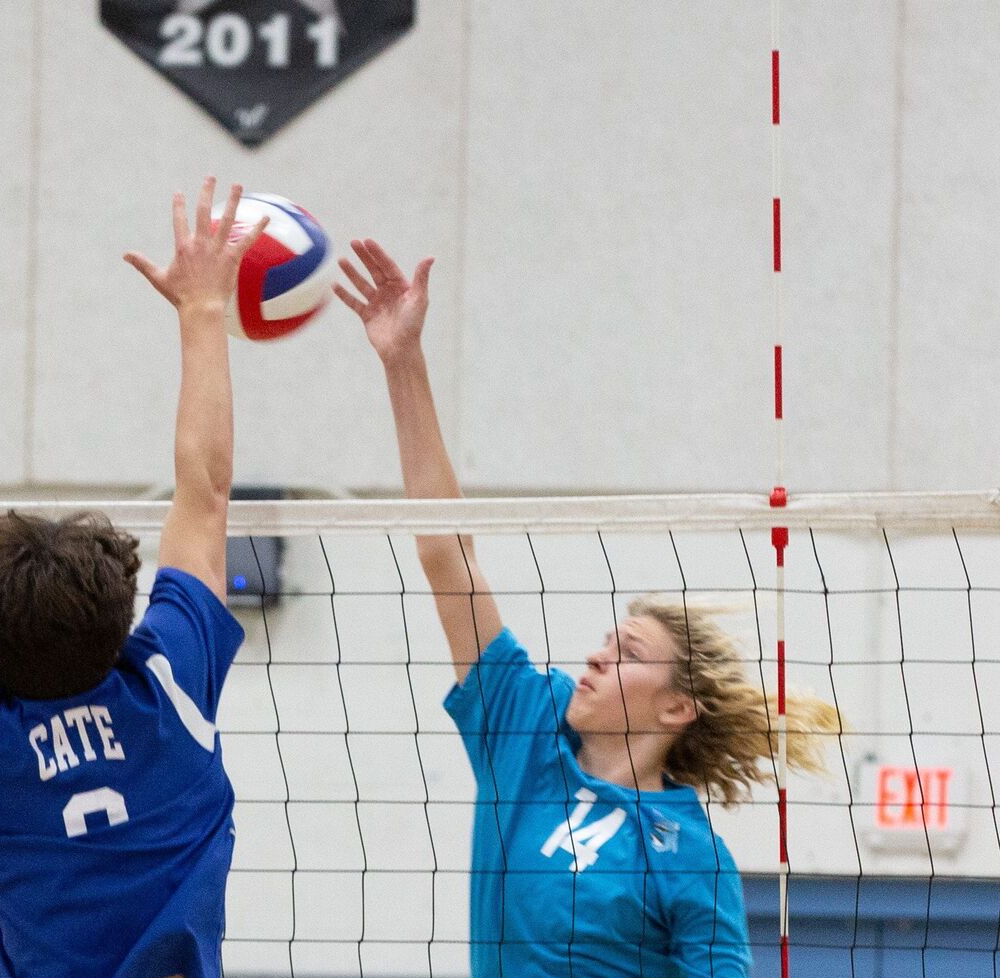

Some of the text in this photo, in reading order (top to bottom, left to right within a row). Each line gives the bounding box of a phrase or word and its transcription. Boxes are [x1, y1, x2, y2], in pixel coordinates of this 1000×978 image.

[158, 13, 341, 68] 2011
[29, 704, 126, 782] CATE
[541, 787, 627, 872] 14
[877, 767, 953, 829] EXIT
